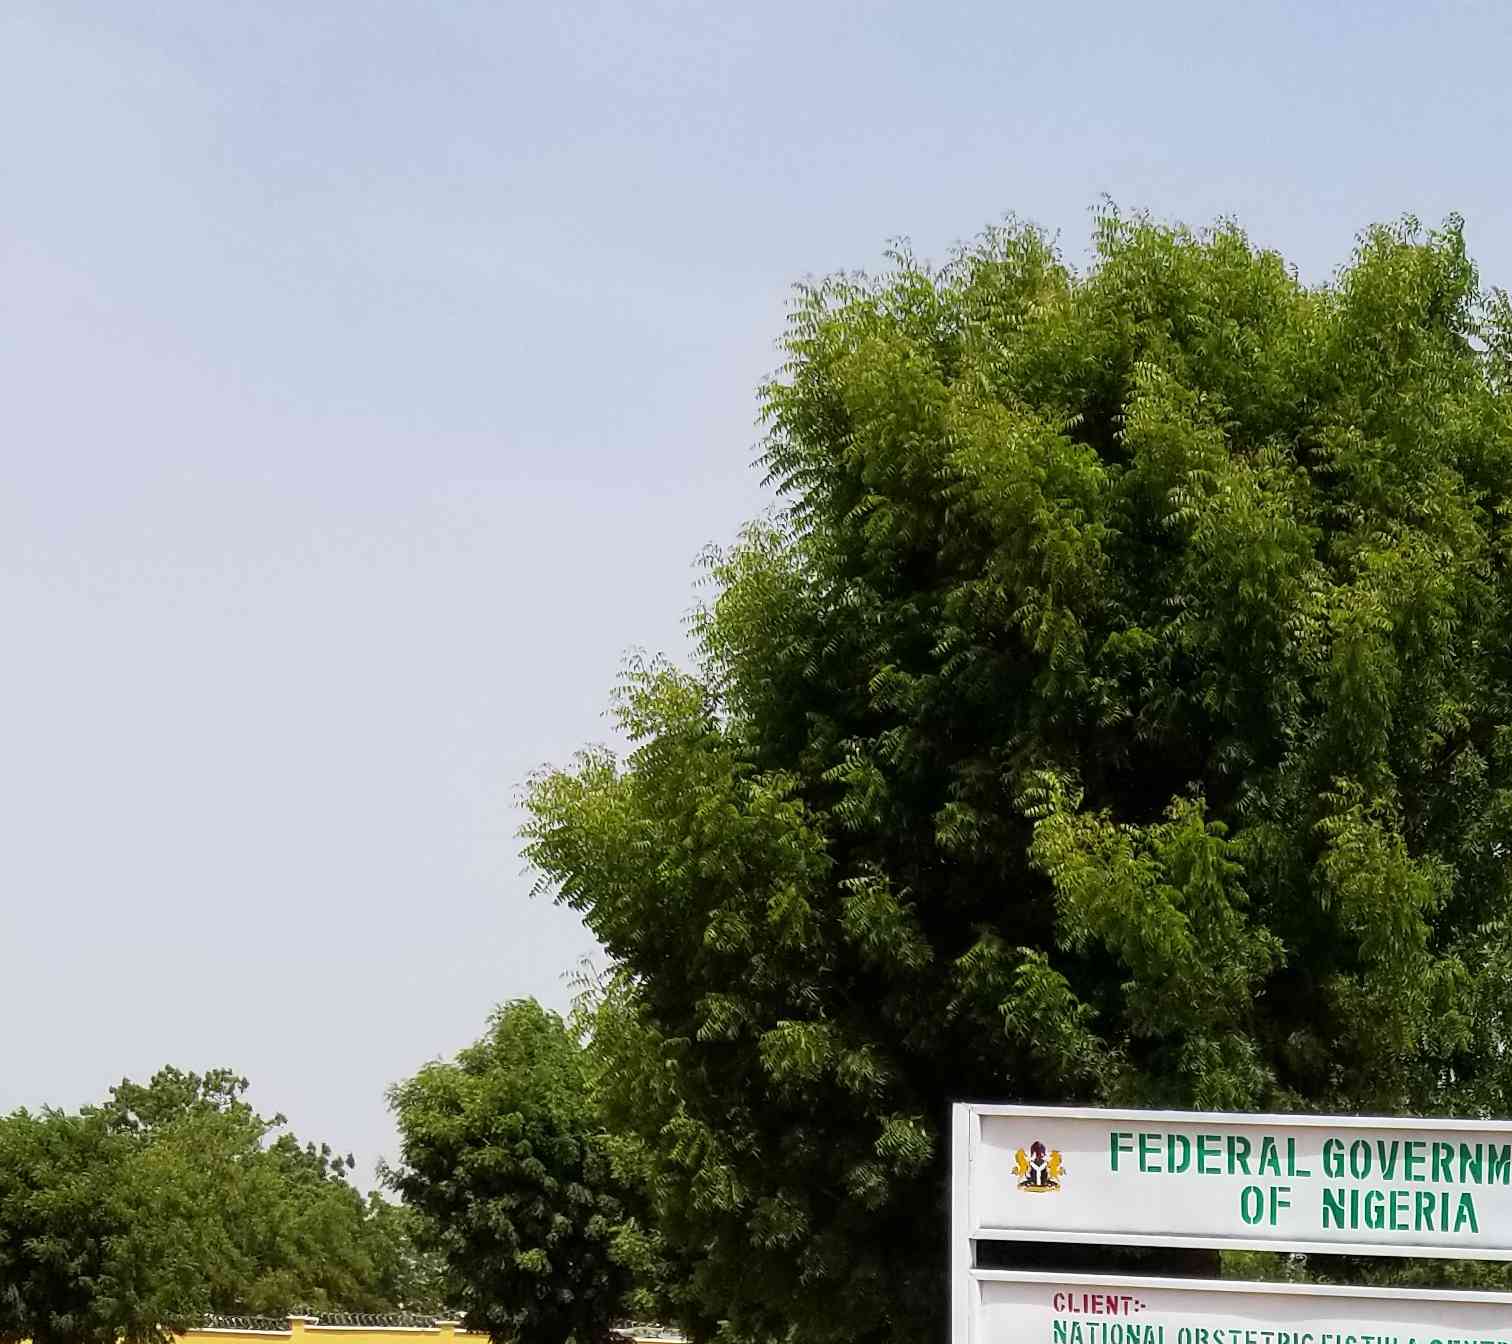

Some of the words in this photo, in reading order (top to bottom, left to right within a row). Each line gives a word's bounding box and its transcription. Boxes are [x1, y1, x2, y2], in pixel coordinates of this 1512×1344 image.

[1110, 1132, 1311, 1178] FEDERAL
[1240, 1185, 1291, 1226] OF
[1322, 1188, 1479, 1234] NIGERIA
